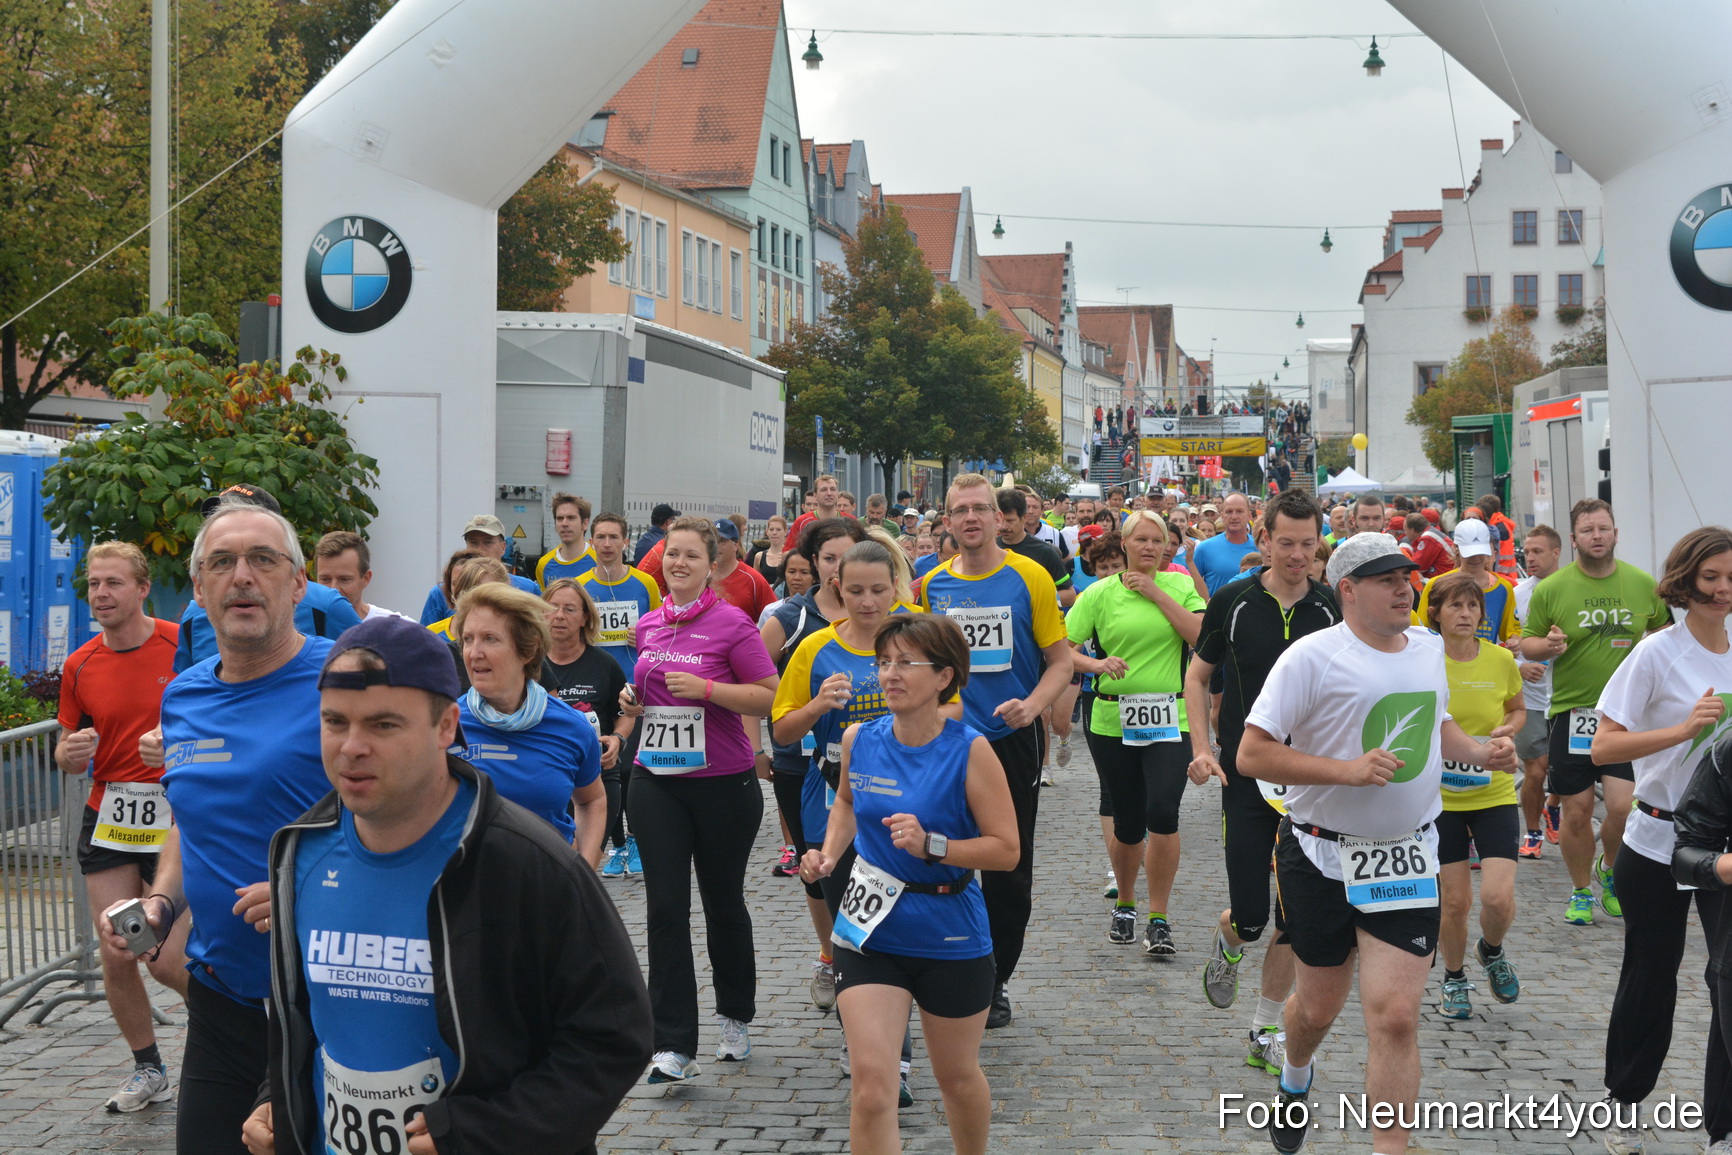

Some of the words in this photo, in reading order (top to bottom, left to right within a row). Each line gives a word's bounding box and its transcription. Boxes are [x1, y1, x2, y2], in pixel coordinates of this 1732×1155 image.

[312, 218, 404, 257] BMW
[750, 411, 779, 454] BOCK
[1181, 441, 1224, 452] START
[1584, 597, 1621, 608] FÜRTH
[600, 612, 630, 630] 164
[1577, 608, 1633, 628] 2012
[1125, 704, 1171, 726] 2601
[645, 723, 695, 748] 2711
[1134, 731, 1167, 739] Susanne
[651, 754, 686, 765] Henrike
[125, 788, 159, 797] Neumarkt
[112, 797, 156, 825] 318
[107, 829, 157, 843] Alexander
[1350, 845, 1427, 880] 2286
[1370, 884, 1418, 900] Michael
[307, 929, 433, 974] HUBER
[327, 968, 428, 989] TECHNOLOGY
[328, 986, 359, 999] WASTE
[360, 990, 392, 1002] WATER
[392, 993, 430, 1007] Solutions
[343, 1081, 416, 1100] Neumarkt
